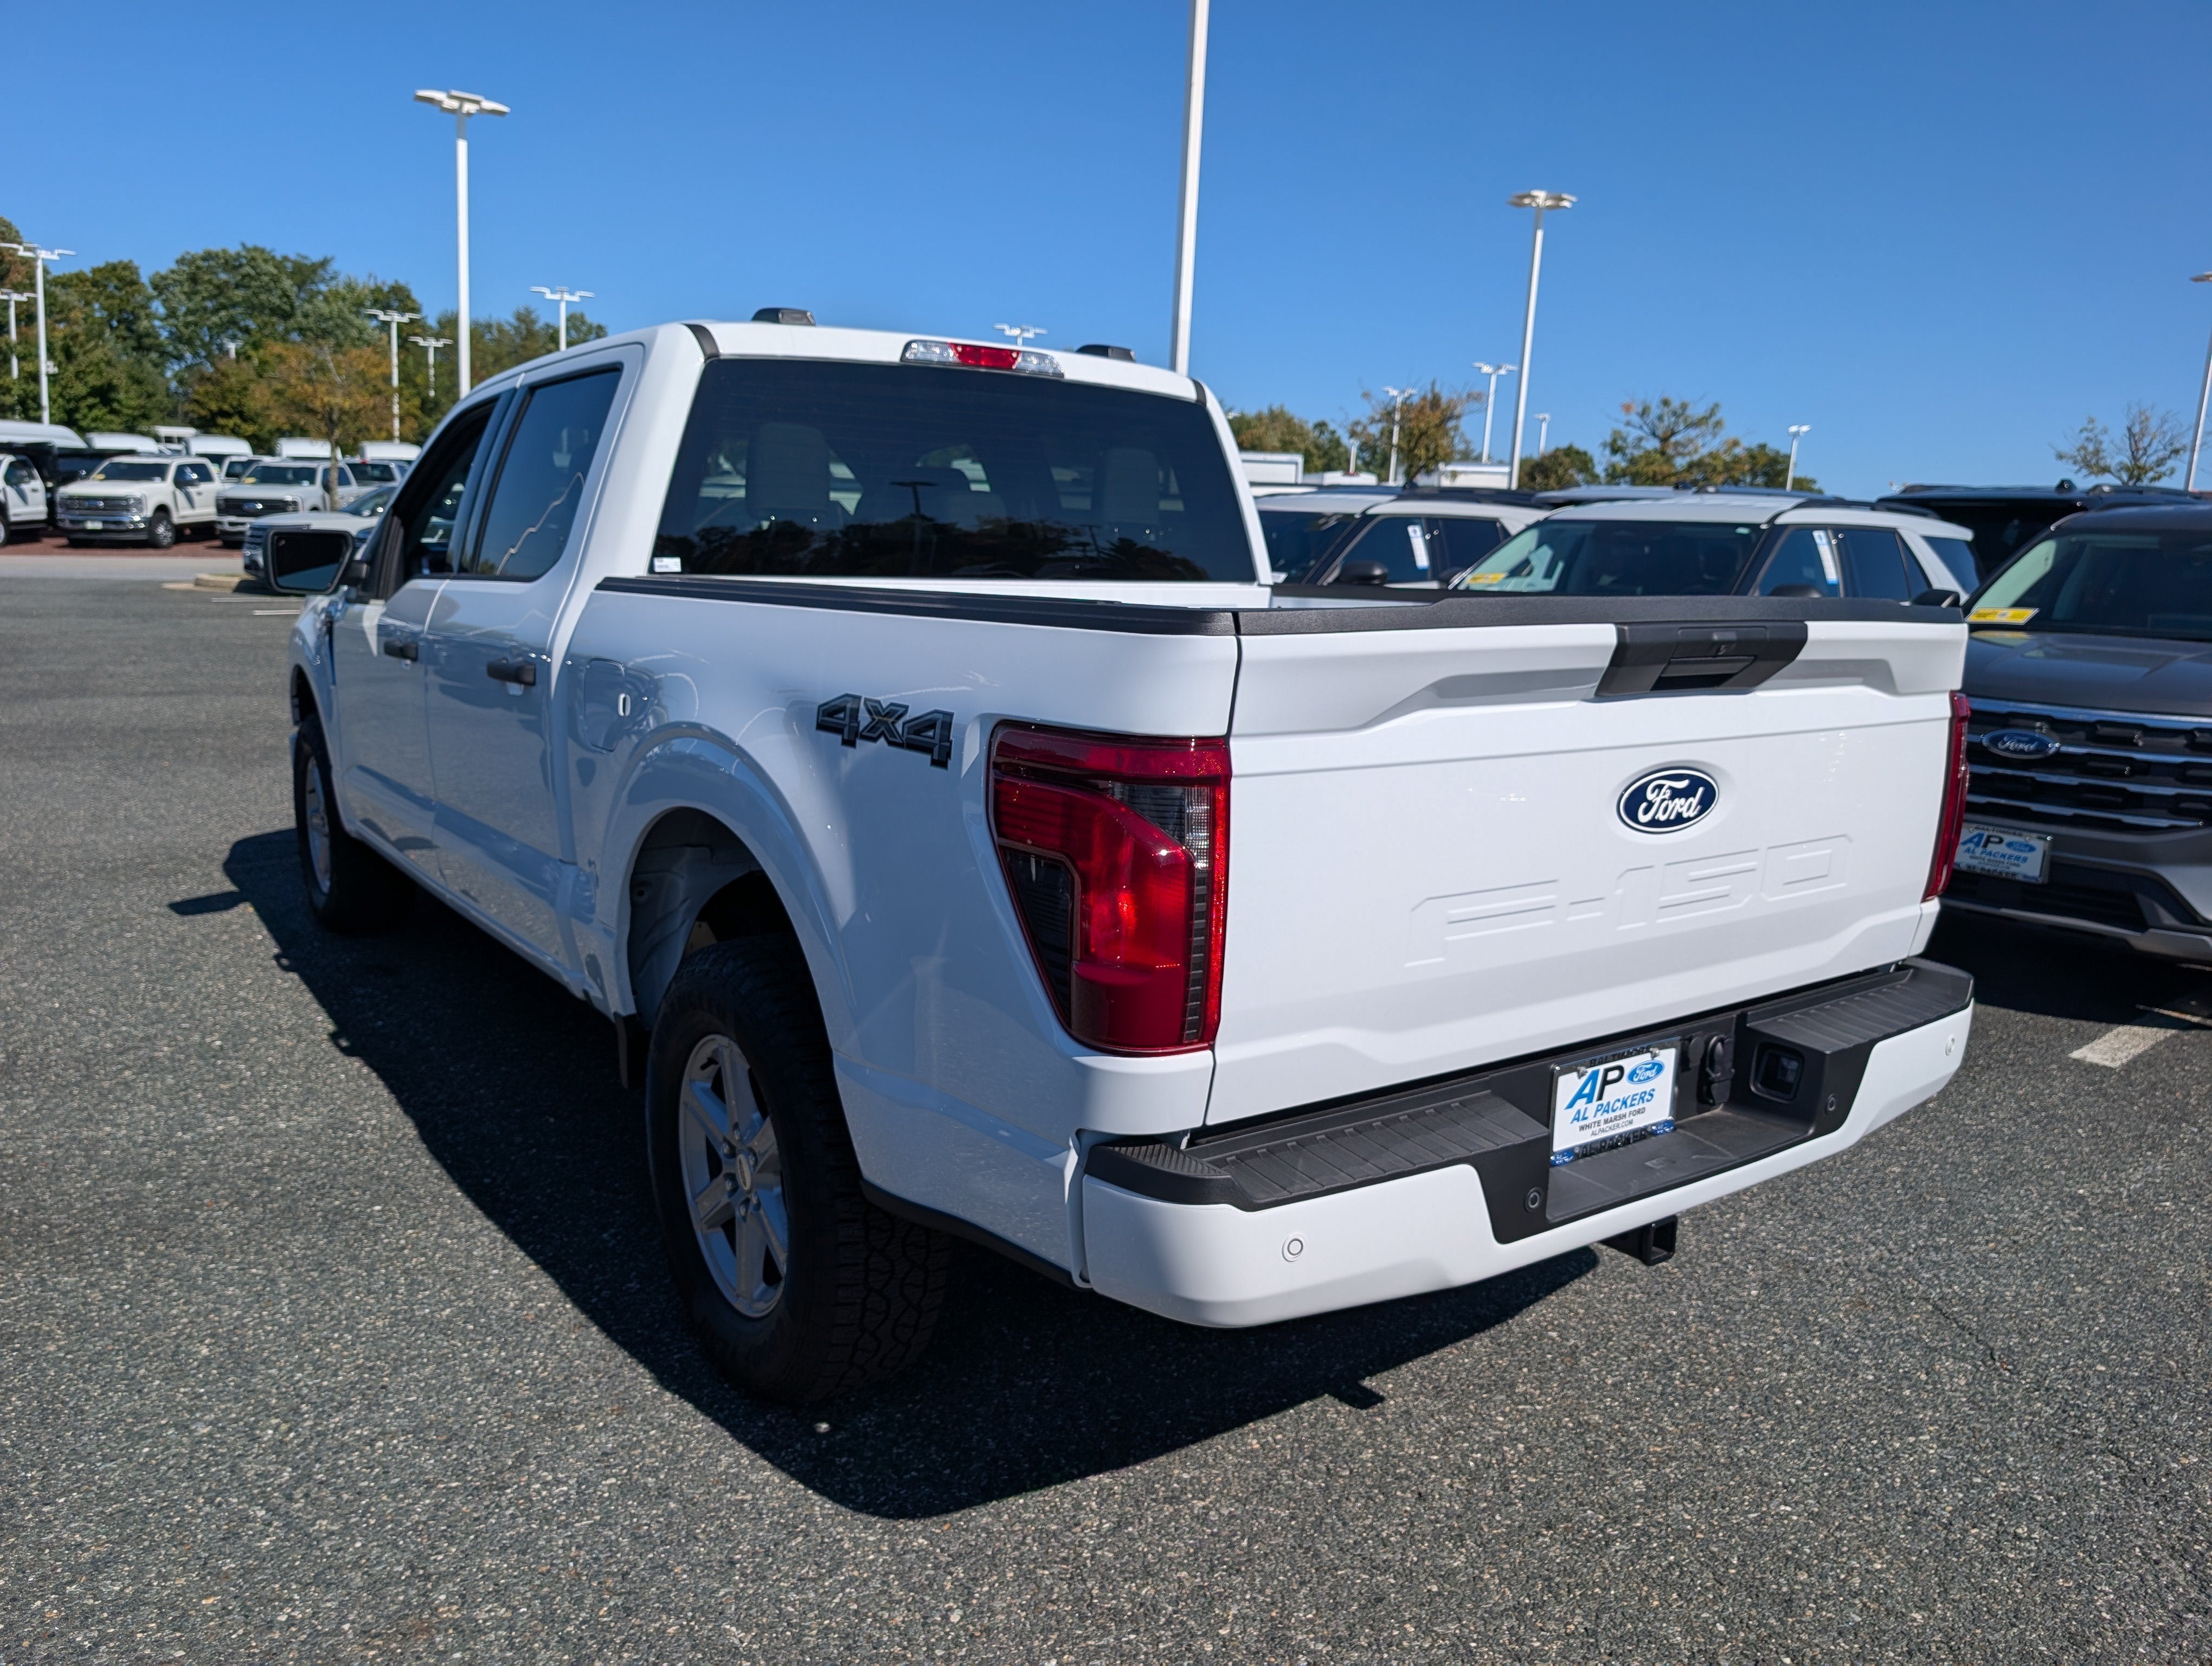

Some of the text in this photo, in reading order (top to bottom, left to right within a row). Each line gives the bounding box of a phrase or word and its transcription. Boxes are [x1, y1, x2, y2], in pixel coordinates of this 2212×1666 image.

[1637, 779, 1705, 823] Ford
[1960, 831, 2004, 849] AP
[1403, 834, 1853, 968] F-150
[1564, 1063, 1625, 1110] AP
[1632, 1063, 1659, 1084] Ford
[1570, 1088, 1656, 1124] AL PACKERS
[1578, 1106, 1646, 1132] WHITE MARSH FORD
[1590, 1119, 1634, 1137] ALPACKER.COM
